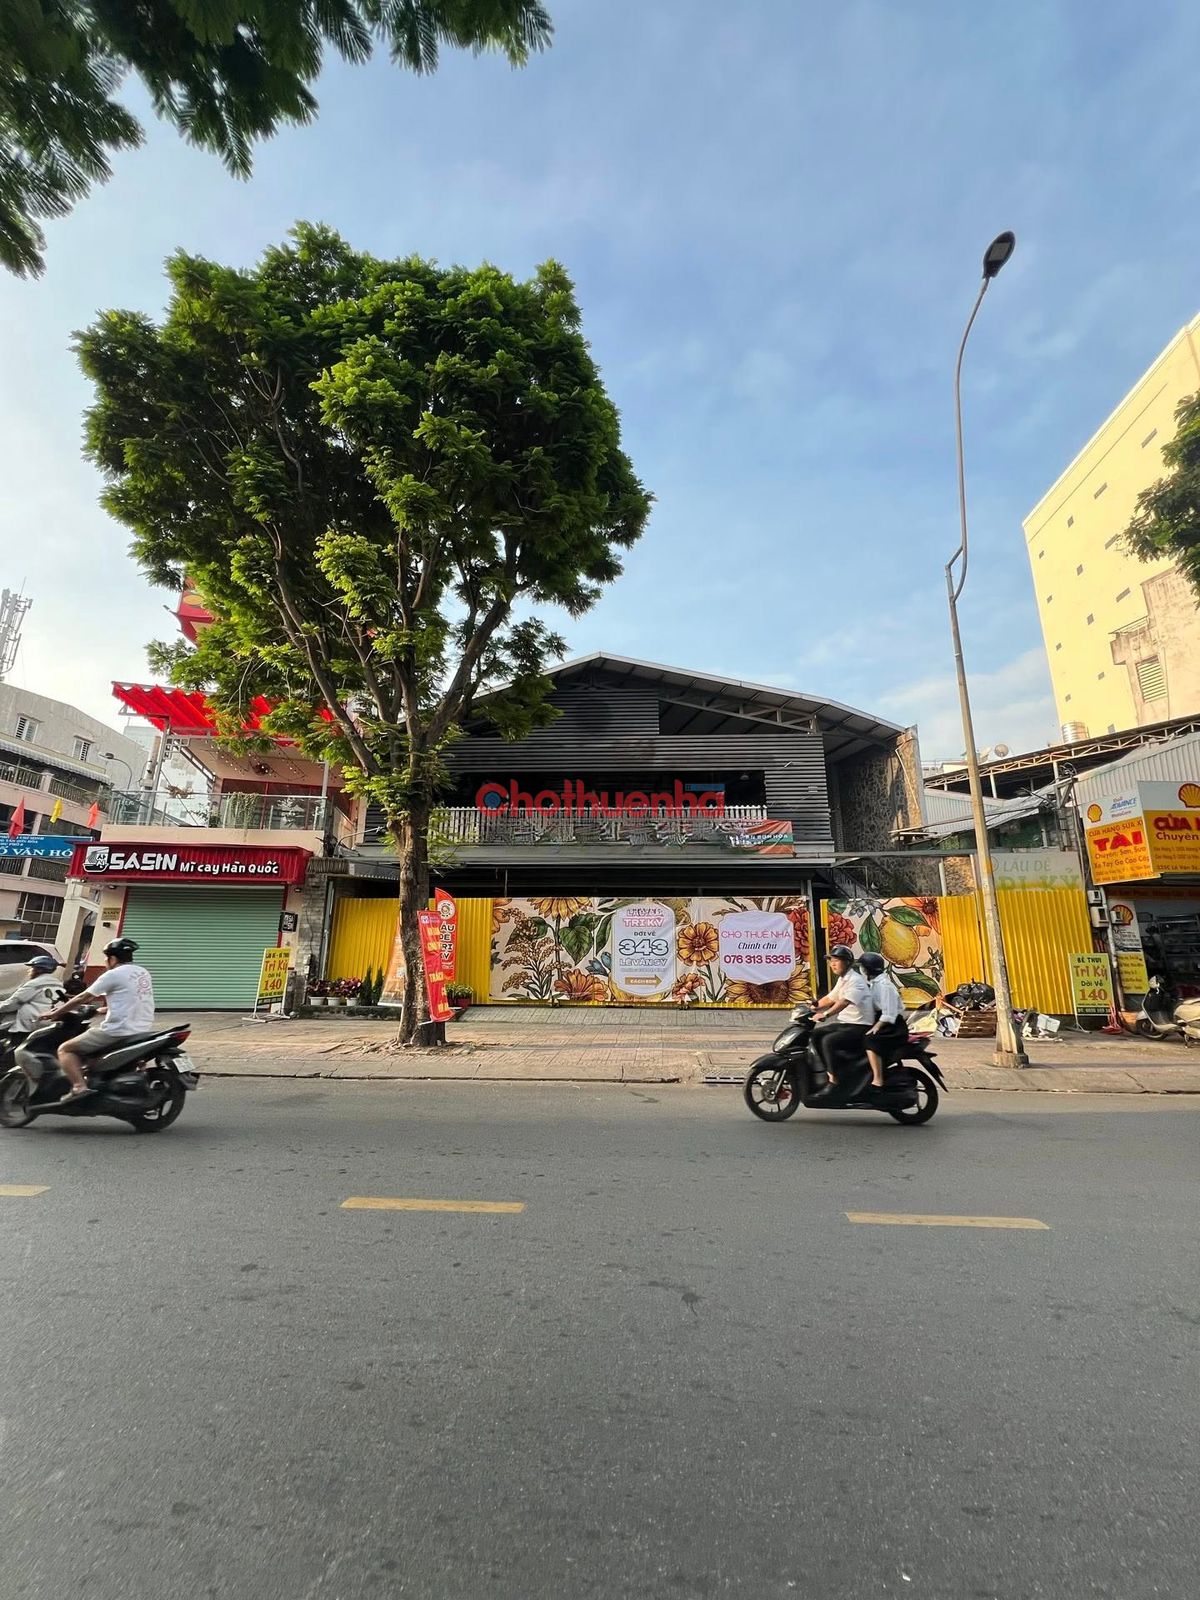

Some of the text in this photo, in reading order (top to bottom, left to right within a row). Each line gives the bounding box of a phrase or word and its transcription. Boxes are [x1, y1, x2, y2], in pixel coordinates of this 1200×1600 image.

[1093, 830, 1143, 852] TÀI
[109, 853, 178, 870] SASIN
[197, 864, 220, 875] cay
[248, 861, 279, 874] Quốc
[721, 930, 741, 939] CHO
[744, 928, 769, 939] THUÊ
[619, 938, 669, 956] 343
[724, 954, 792, 964] 076 313 5335
[264, 978, 282, 991] 140
[1079, 988, 1108, 1001] 140
